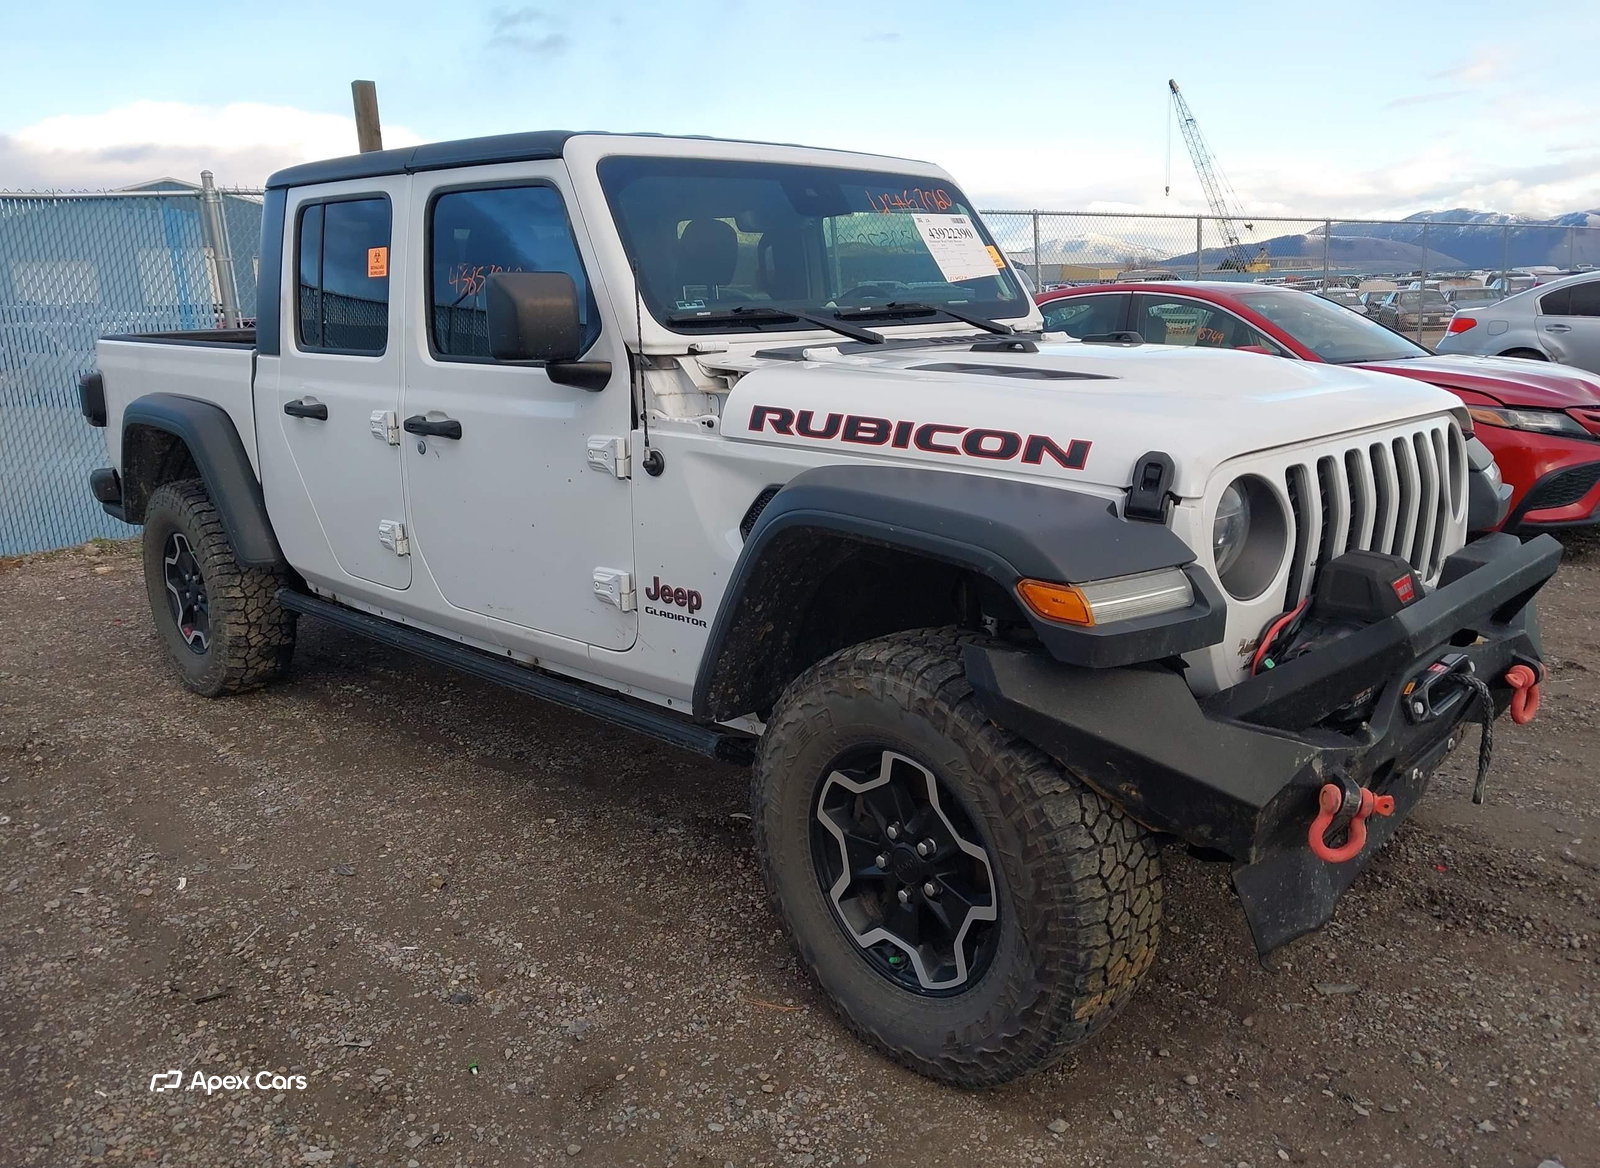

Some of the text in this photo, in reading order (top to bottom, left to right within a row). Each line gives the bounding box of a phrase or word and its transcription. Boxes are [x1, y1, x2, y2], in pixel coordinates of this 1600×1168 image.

[928, 227, 974, 240] 43922390
[748, 404, 1093, 471] RUBICON
[645, 576, 703, 614] Jeep
[645, 606, 707, 628] GLADIATOR
